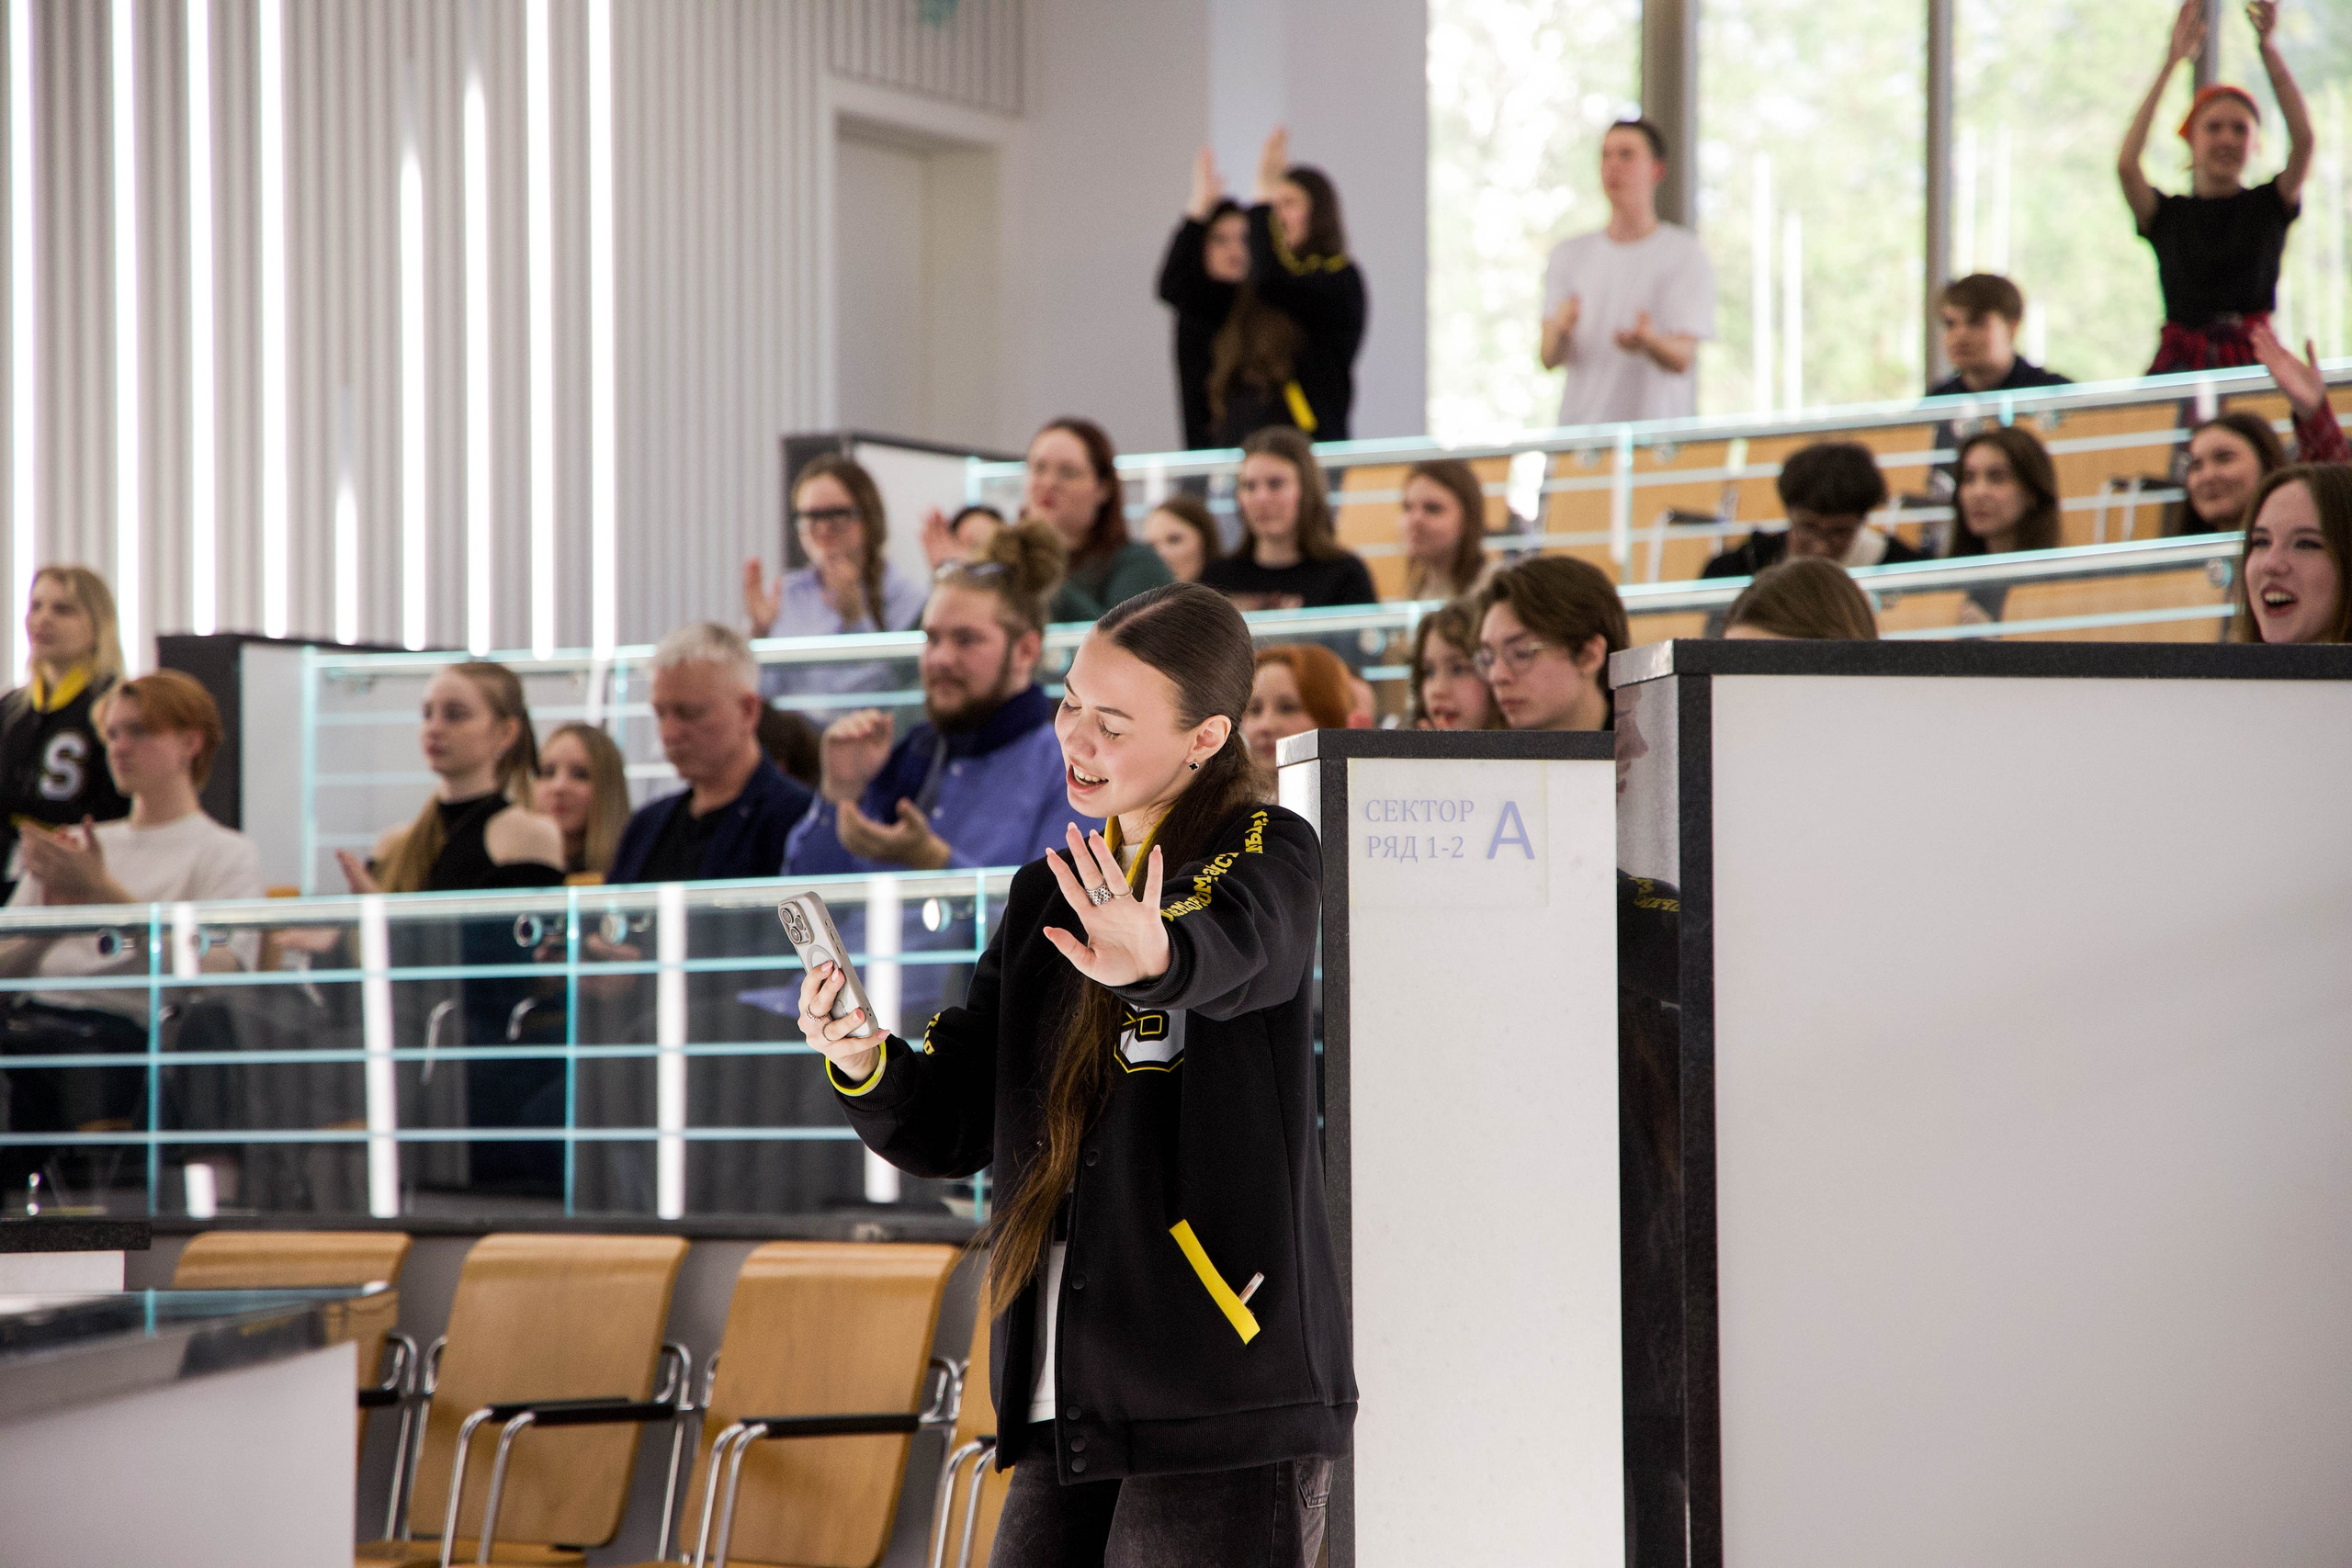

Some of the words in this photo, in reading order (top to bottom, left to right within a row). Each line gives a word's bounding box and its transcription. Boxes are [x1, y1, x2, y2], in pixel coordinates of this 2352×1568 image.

[40, 731, 86, 801] S
[1365, 799, 1475, 822] СЕКТОР
[1487, 800, 1535, 860] А
[1367, 835, 1419, 863] РЯД
[1427, 836, 1464, 859] 1-2
